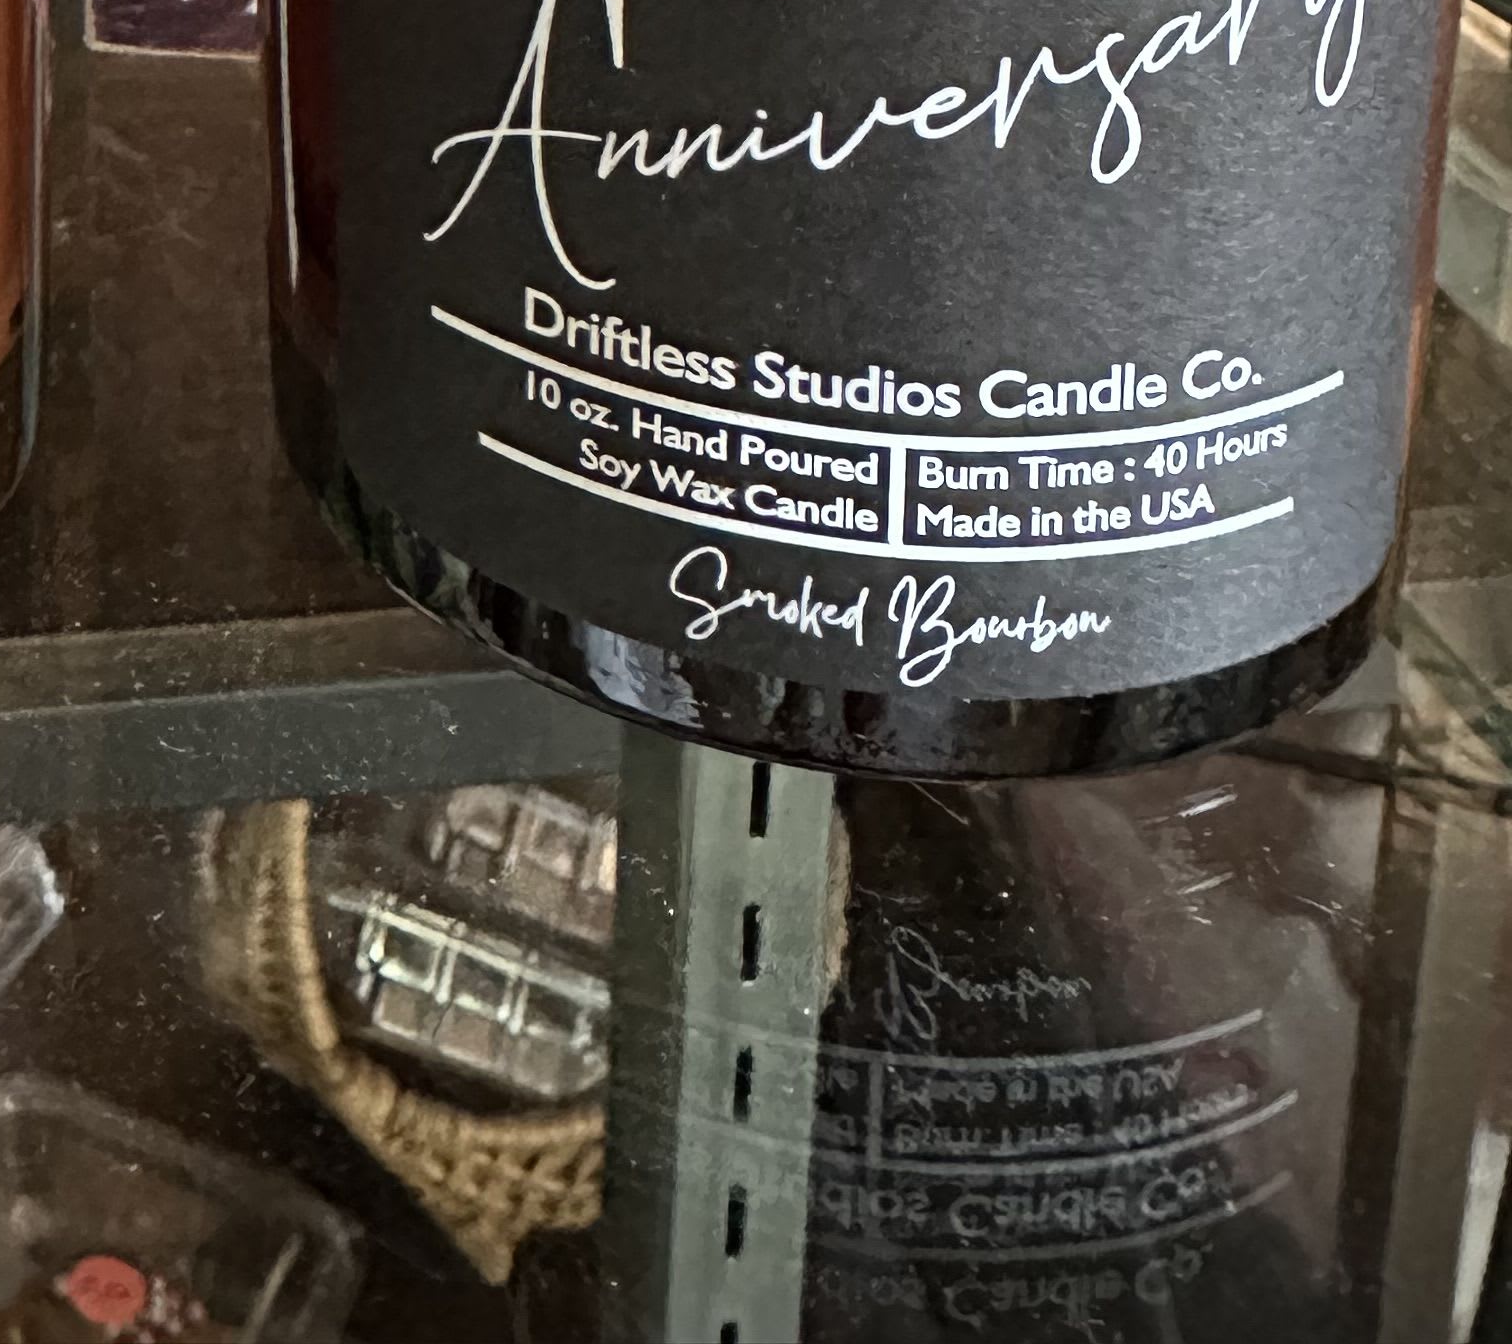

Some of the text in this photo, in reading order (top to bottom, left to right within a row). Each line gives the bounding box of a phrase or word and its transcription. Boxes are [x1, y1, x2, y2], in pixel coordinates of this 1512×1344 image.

[524, 286, 1263, 419] Driftless Studios Candle Co.
[527, 370, 879, 486] 10 oz. Hand Poured
[918, 455, 1009, 491] Burn
[1017, 455, 1115, 490] Time
[1143, 440, 1188, 478] 40
[1196, 423, 1288, 470] Hours
[579, 438, 879, 533] Soy Wax Candle
[916, 483, 1216, 538] Made in the USA
[669, 545, 1112, 688] Smoked Bourbon
